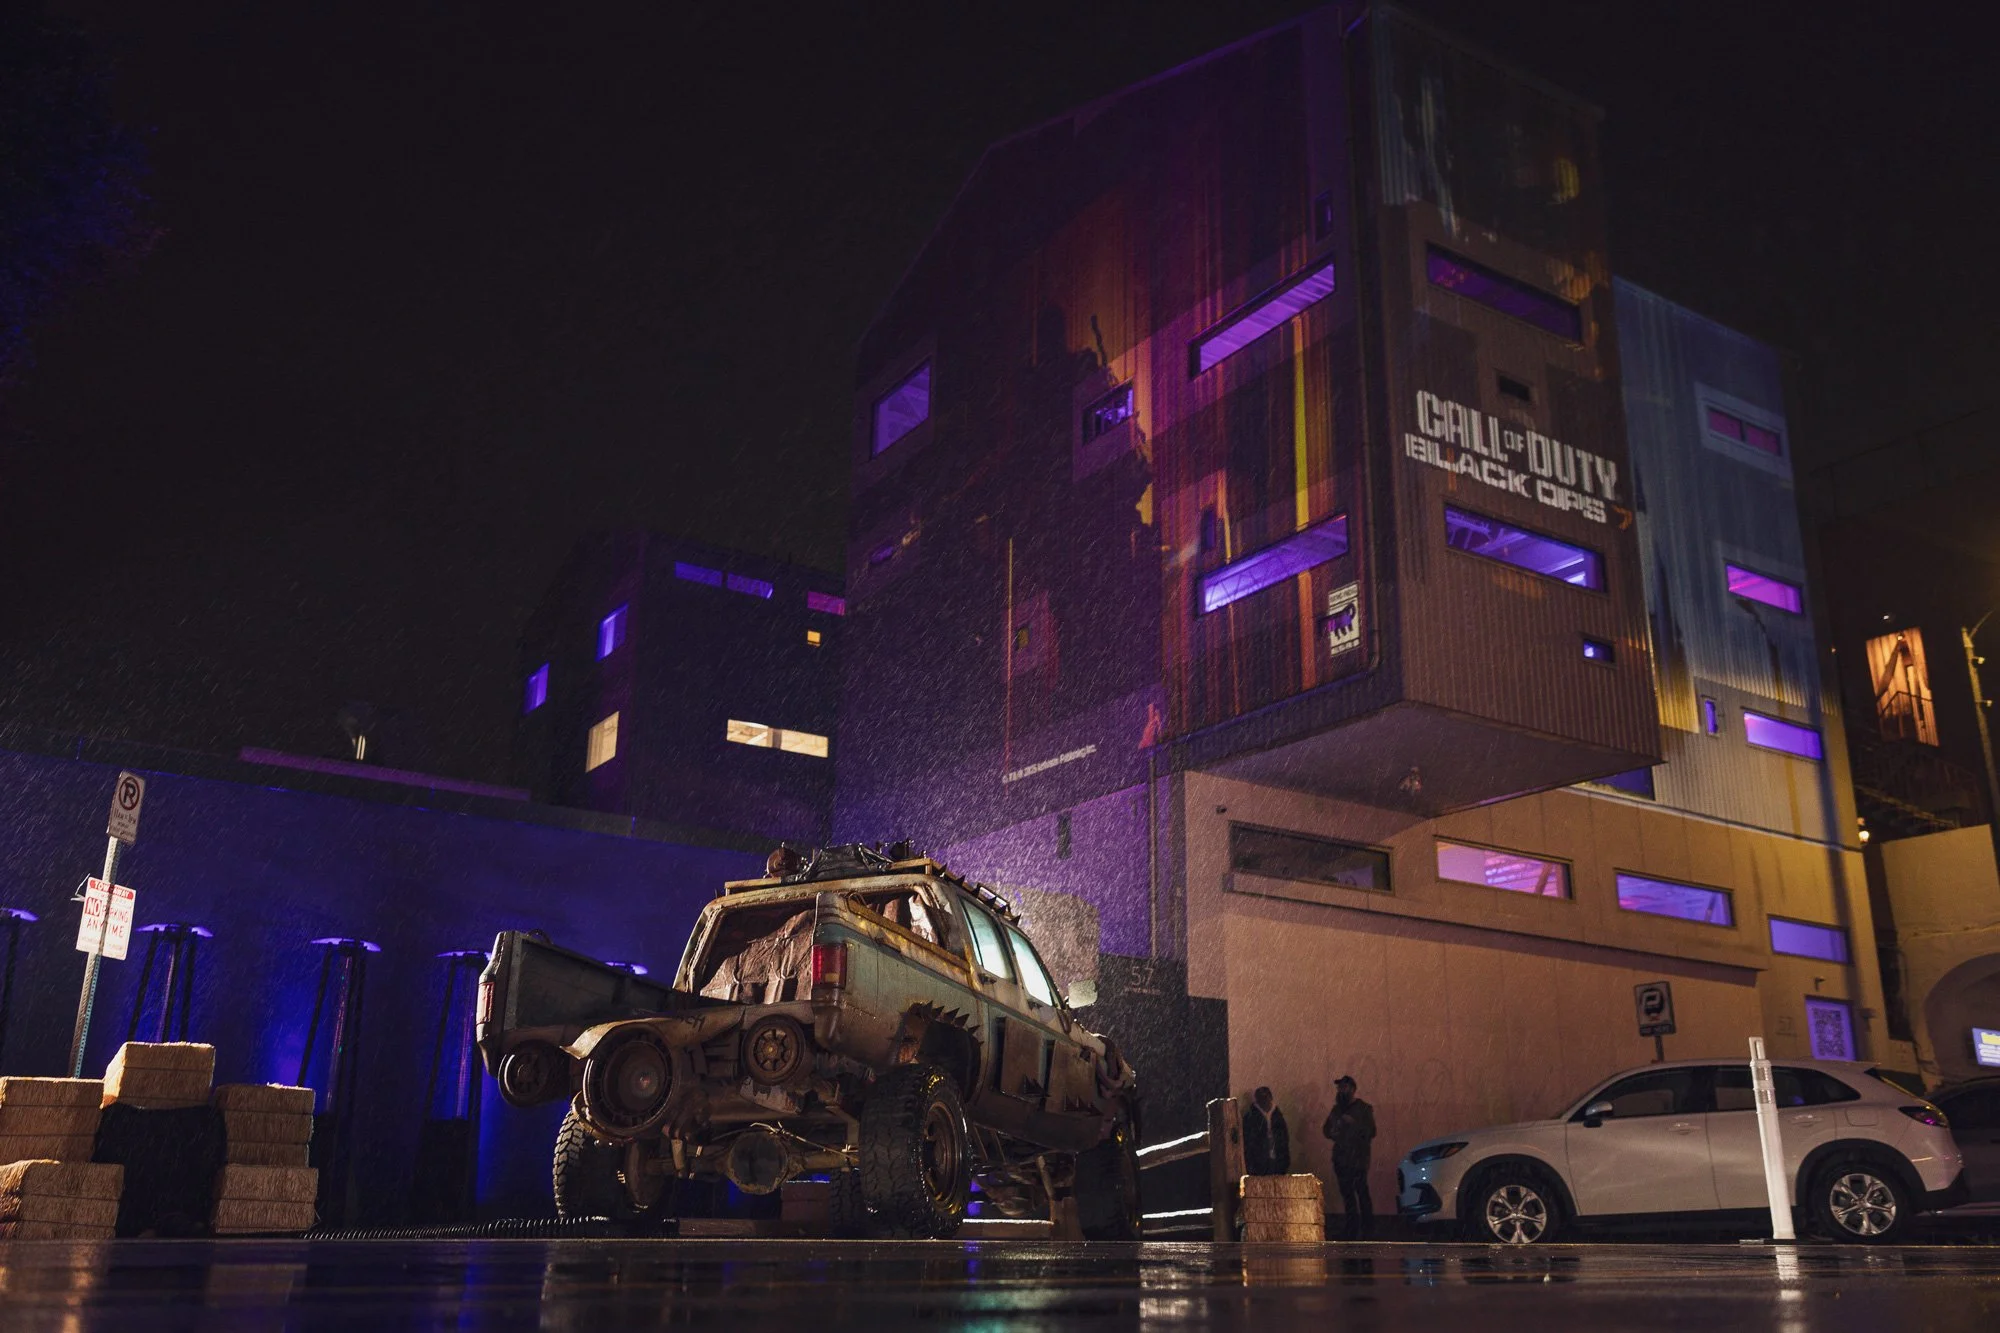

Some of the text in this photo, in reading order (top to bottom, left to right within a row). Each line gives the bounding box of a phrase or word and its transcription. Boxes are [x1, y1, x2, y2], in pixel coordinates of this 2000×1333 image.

[1405, 433, 1532, 498] BLACK
[1536, 480, 1607, 523] OPS
[1416, 390, 1617, 500] CALL OF DUTY
[87, 898, 101, 916] NO
